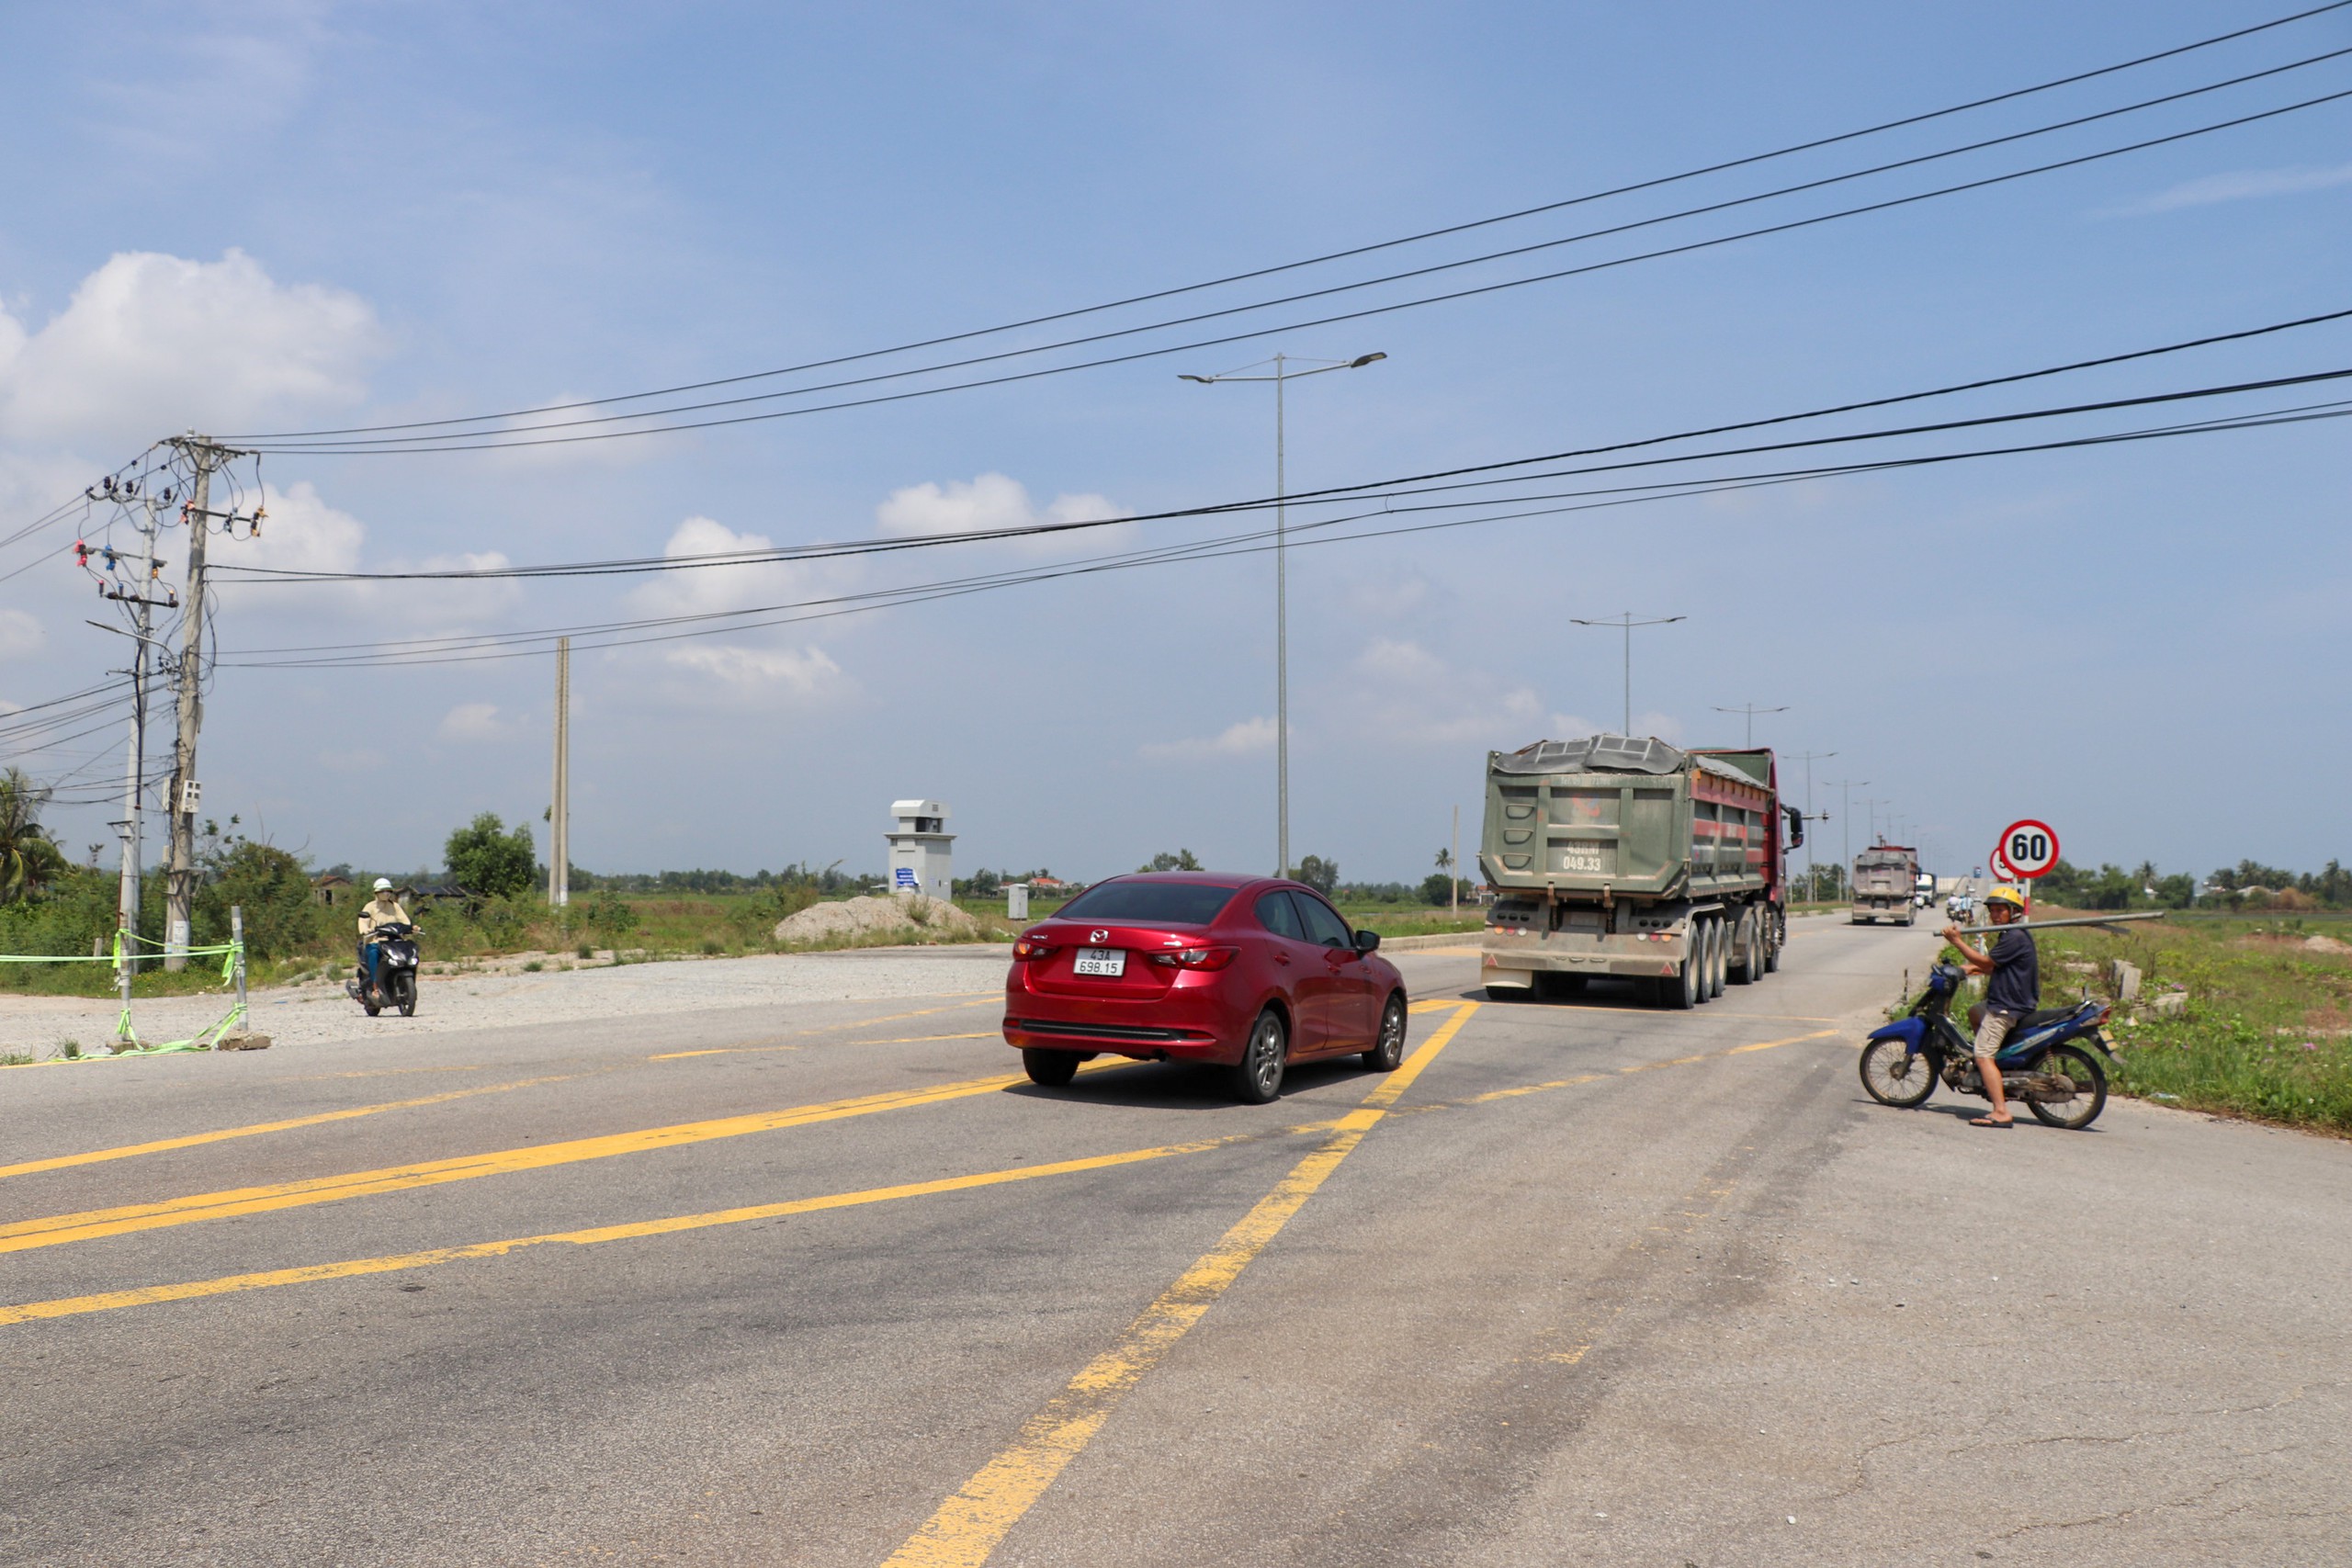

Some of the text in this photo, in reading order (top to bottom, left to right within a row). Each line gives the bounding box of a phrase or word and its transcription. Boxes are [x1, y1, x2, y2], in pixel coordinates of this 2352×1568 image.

[2012, 834, 2046, 861] 60
[1563, 856, 1601, 871] 049.33
[1090, 950, 1111, 961] 43A
[1080, 961, 1118, 974] 698.15
